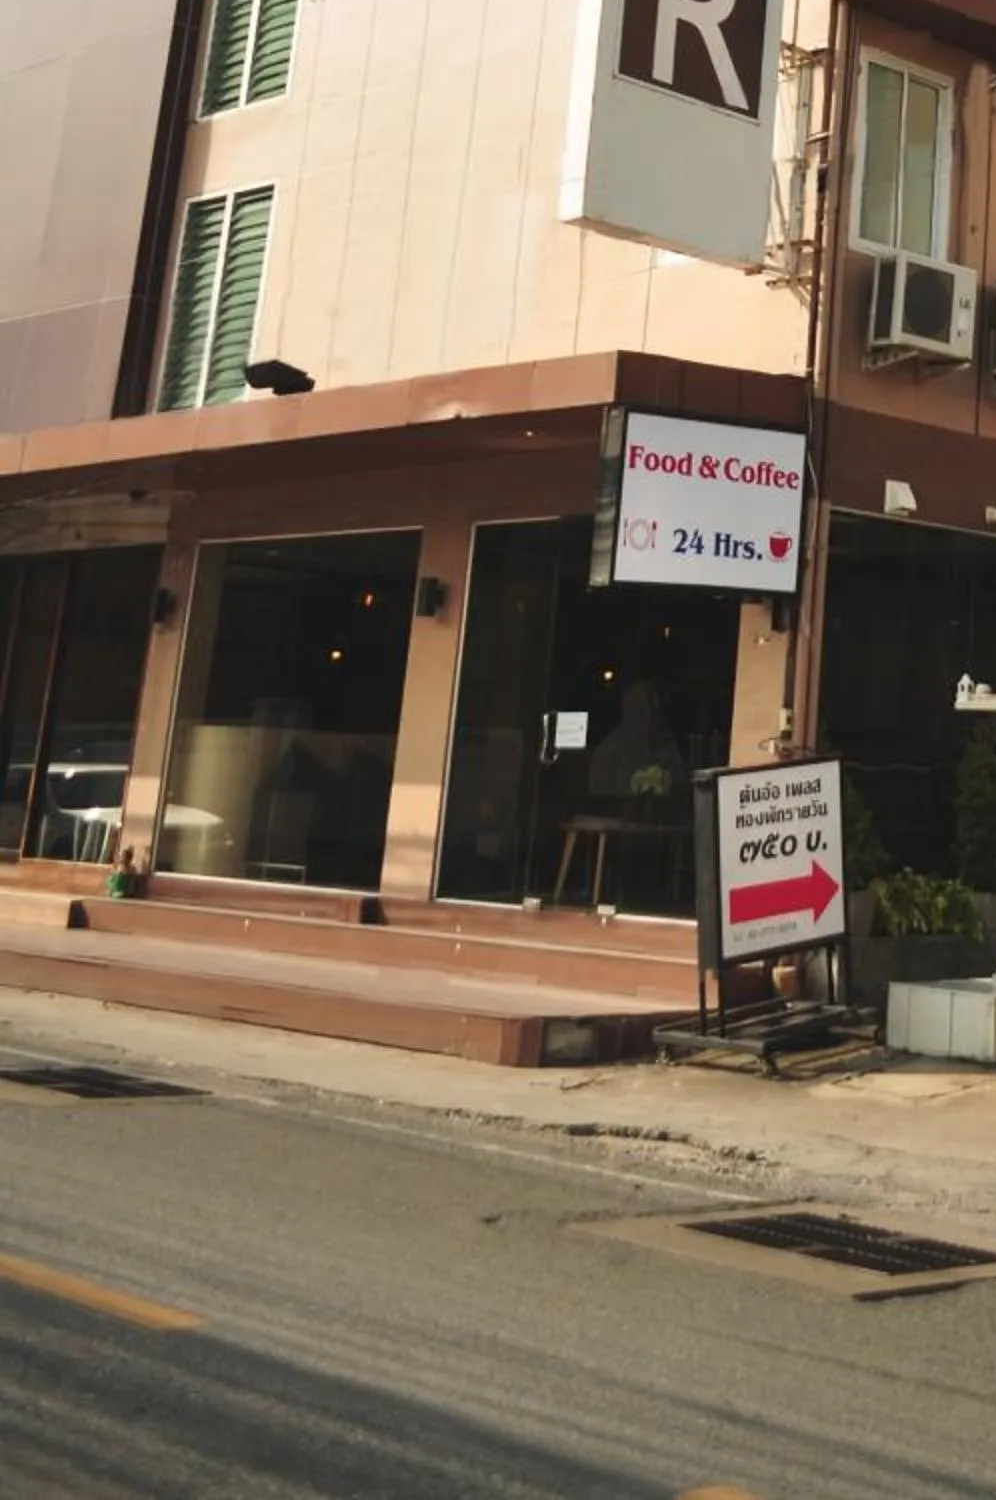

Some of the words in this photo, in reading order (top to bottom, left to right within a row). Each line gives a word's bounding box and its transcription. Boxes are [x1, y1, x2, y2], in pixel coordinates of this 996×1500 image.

[628, 445, 693, 477] Food
[699, 455, 720, 479] &
[724, 457, 800, 490] Coffee
[673, 528, 705, 555] 24
[714, 531, 763, 561] Hrs.
[739, 832, 798, 864] ๗๕๐
